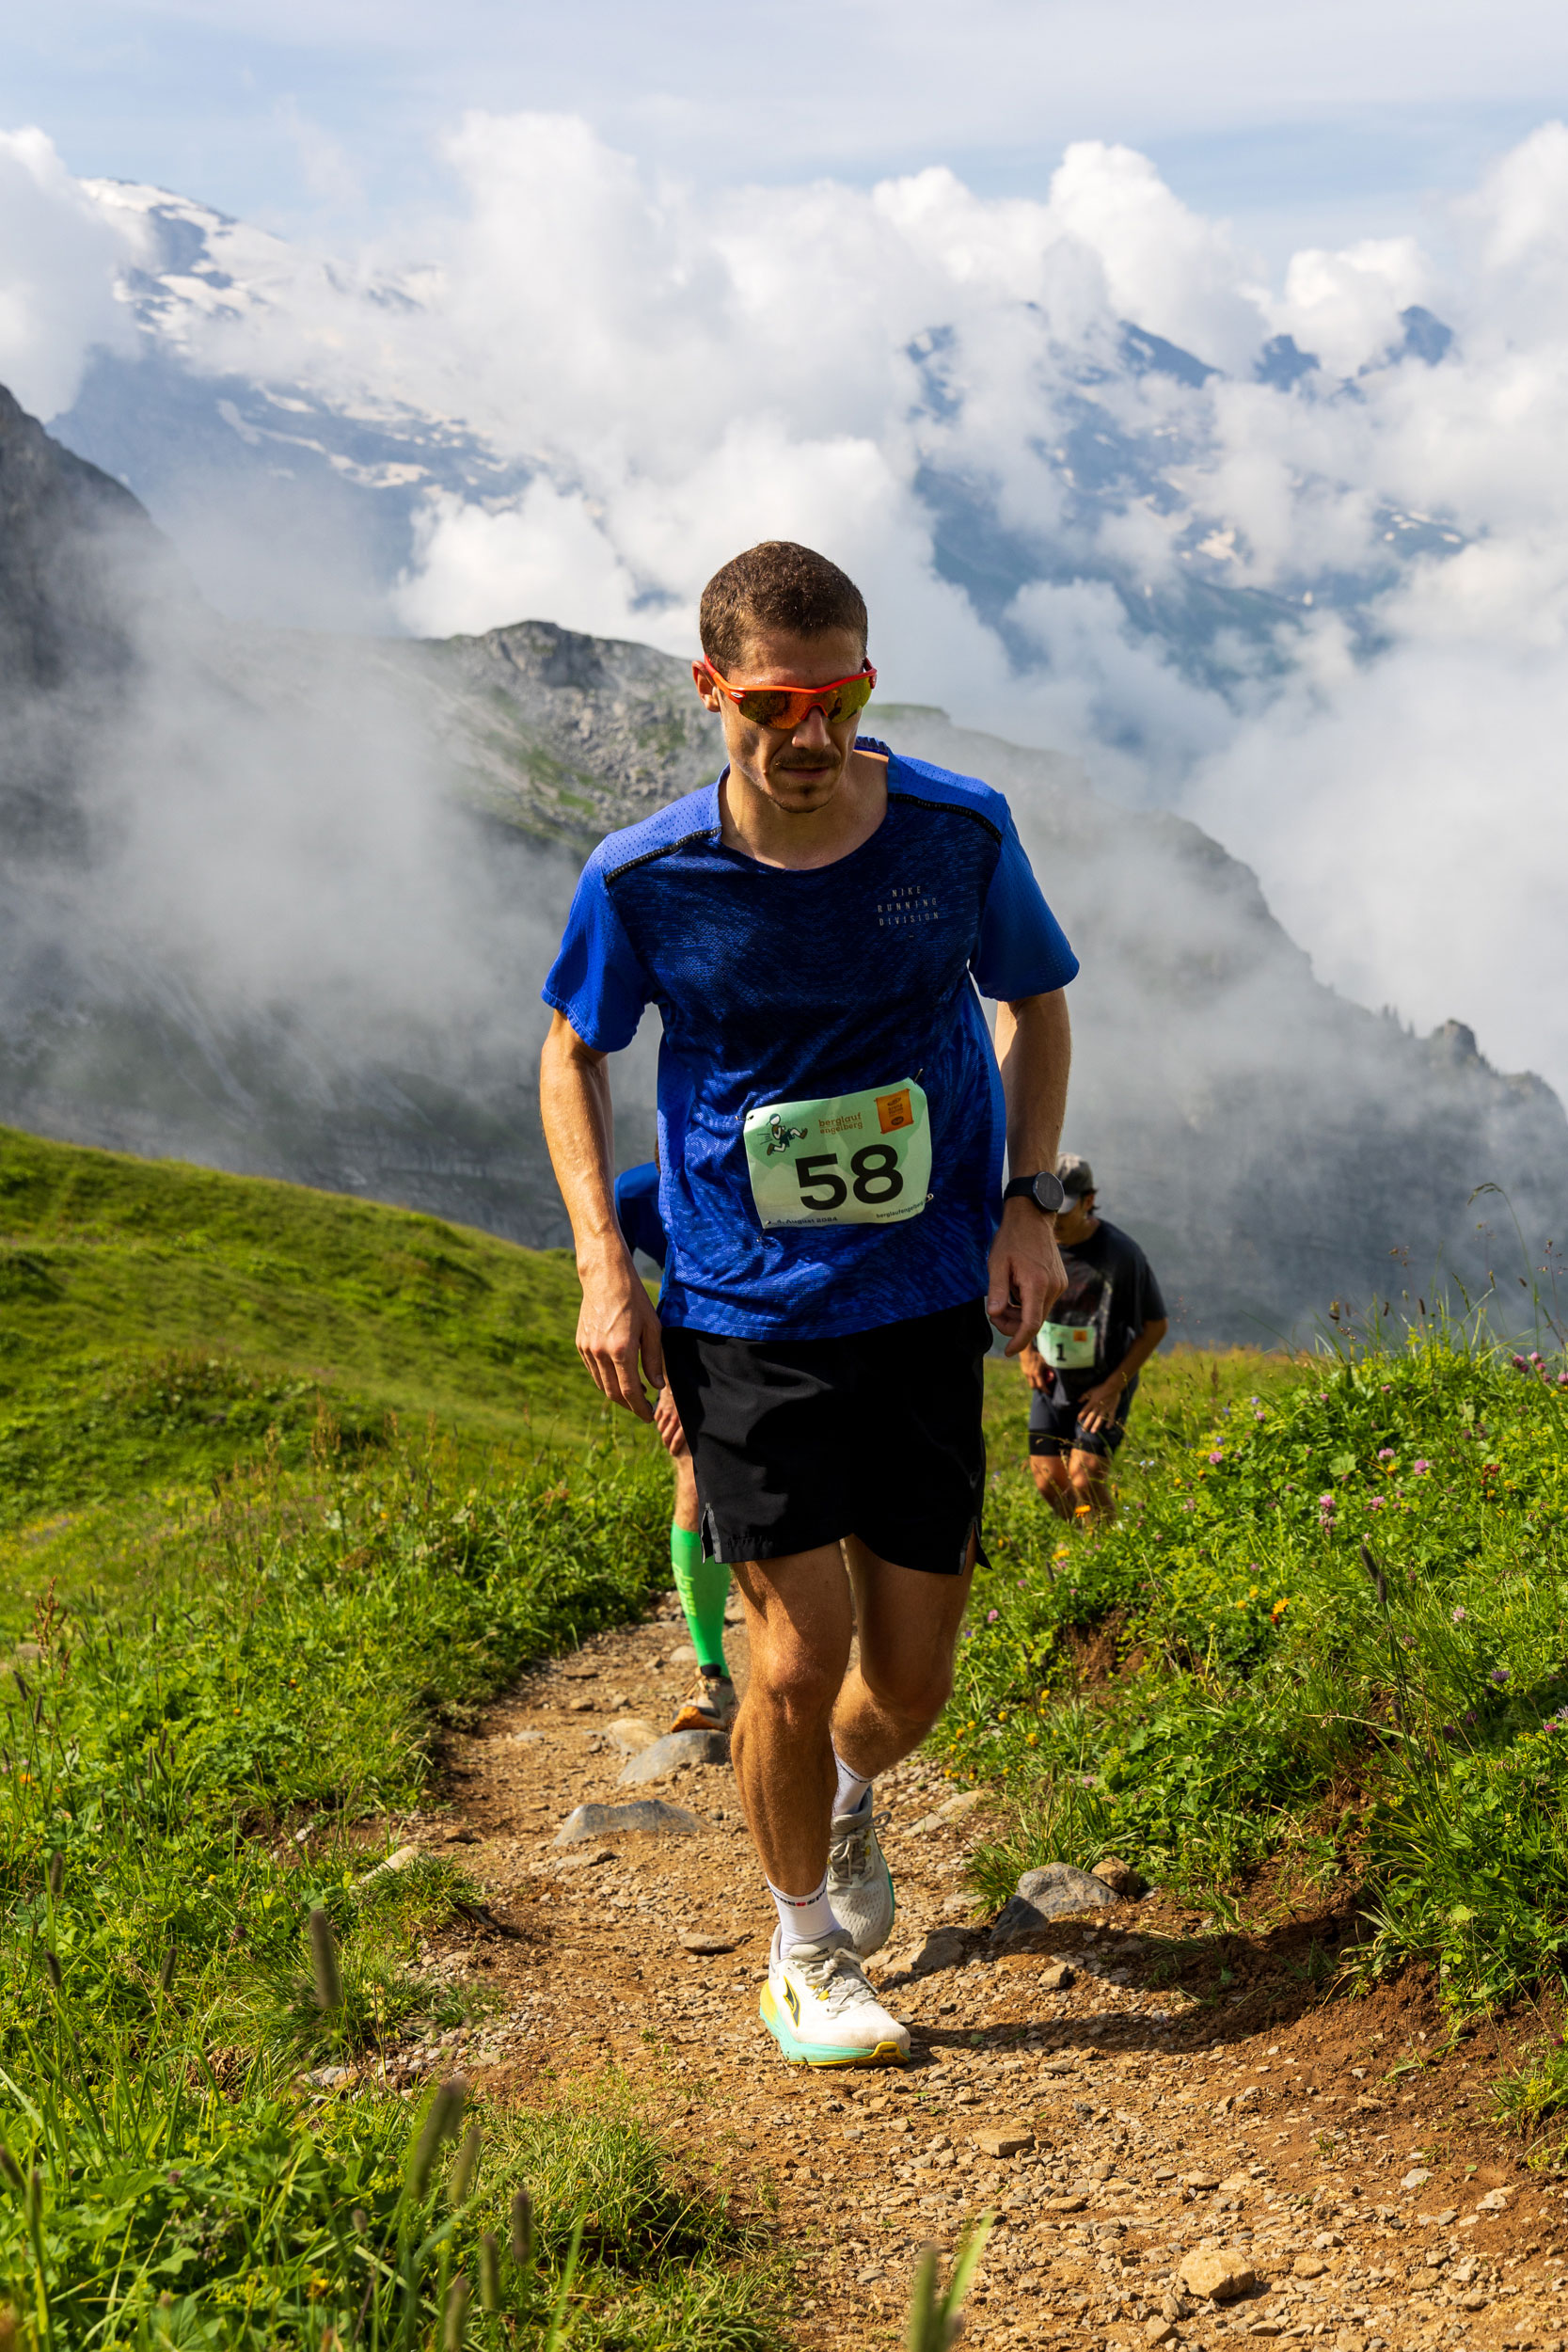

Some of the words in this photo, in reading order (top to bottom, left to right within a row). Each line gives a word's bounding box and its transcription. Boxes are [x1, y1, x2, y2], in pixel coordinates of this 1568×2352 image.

[892, 885, 922, 898] NIKE
[877, 898, 938, 914] RUNNING
[879, 912, 939, 927] DIVISION
[818, 1112, 862, 1127] berglauf
[819, 1121, 863, 1135] engelberg
[795, 1144, 904, 1211] 58
[876, 1199, 926, 1218] berglaufengelberg
[785, 1217, 815, 1226] August
[1056, 1343, 1067, 1361] 1
